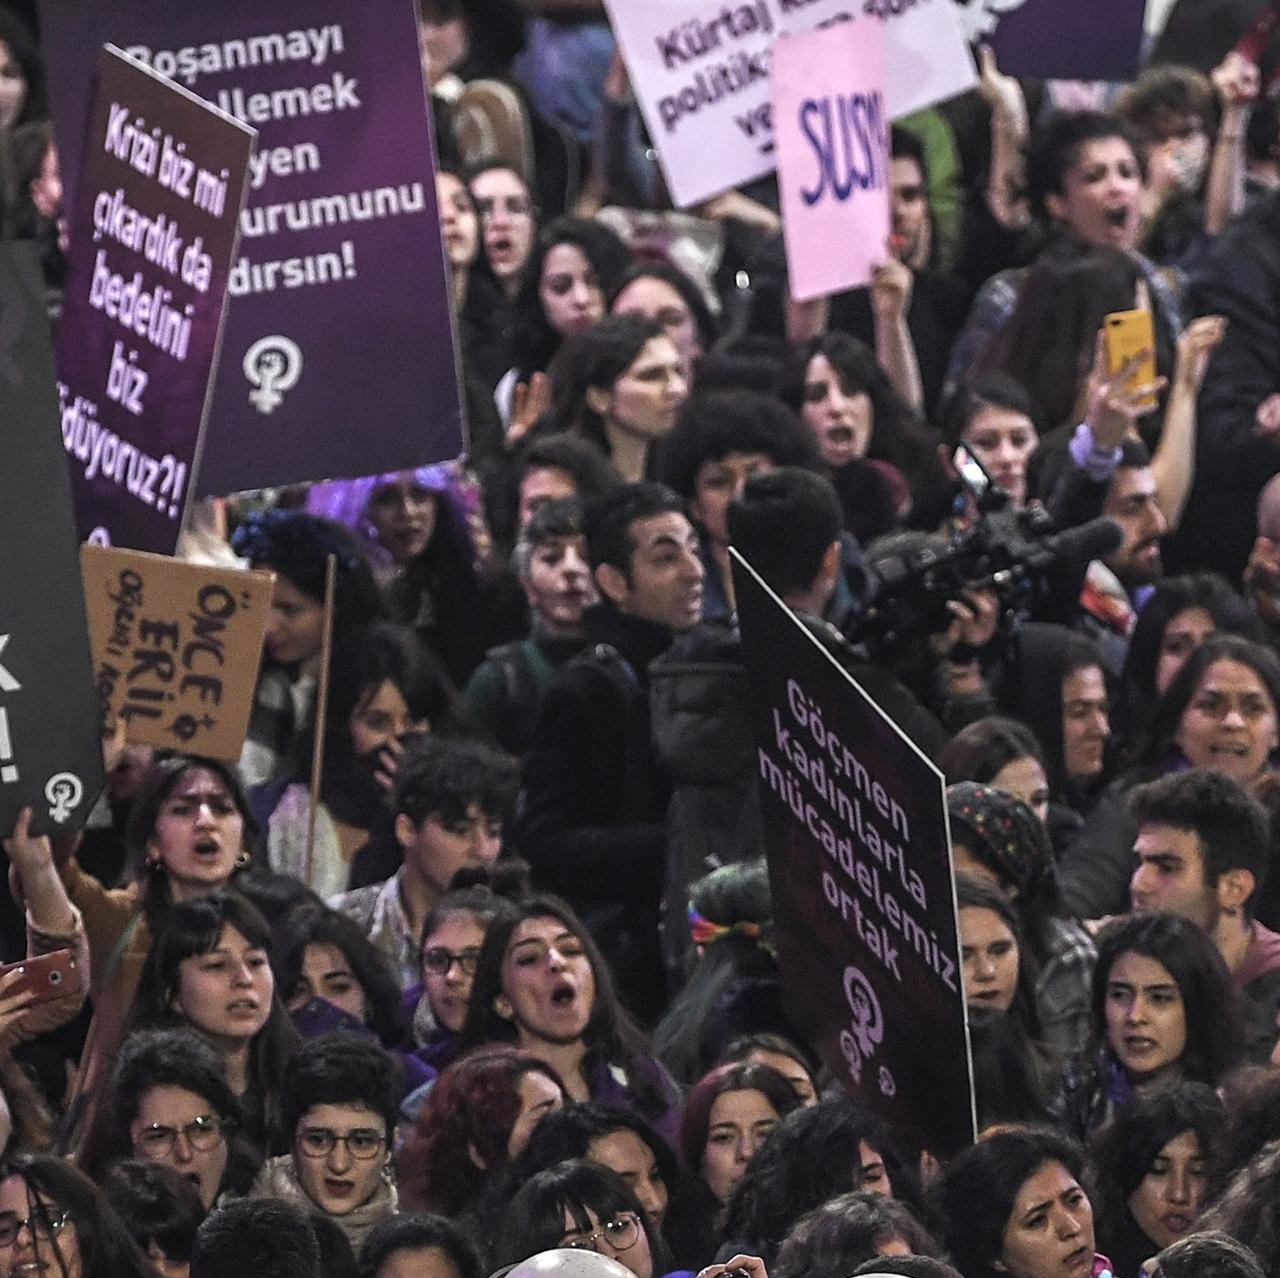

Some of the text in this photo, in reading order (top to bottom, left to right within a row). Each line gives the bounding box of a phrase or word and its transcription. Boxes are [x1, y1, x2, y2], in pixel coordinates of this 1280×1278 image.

[104, 103, 230, 218] Krizi biz mi
[239, 183, 425, 237] urumunu
[93, 188, 213, 293] çıkardık da
[89, 249, 194, 361] bedelini
[106, 340, 149, 416] biz
[773, 708, 928, 911] kadınlarla
[786, 678, 910, 841] Göçmen
[758, 747, 958, 992] mücadelemiz
[821, 871, 901, 982] ortak
